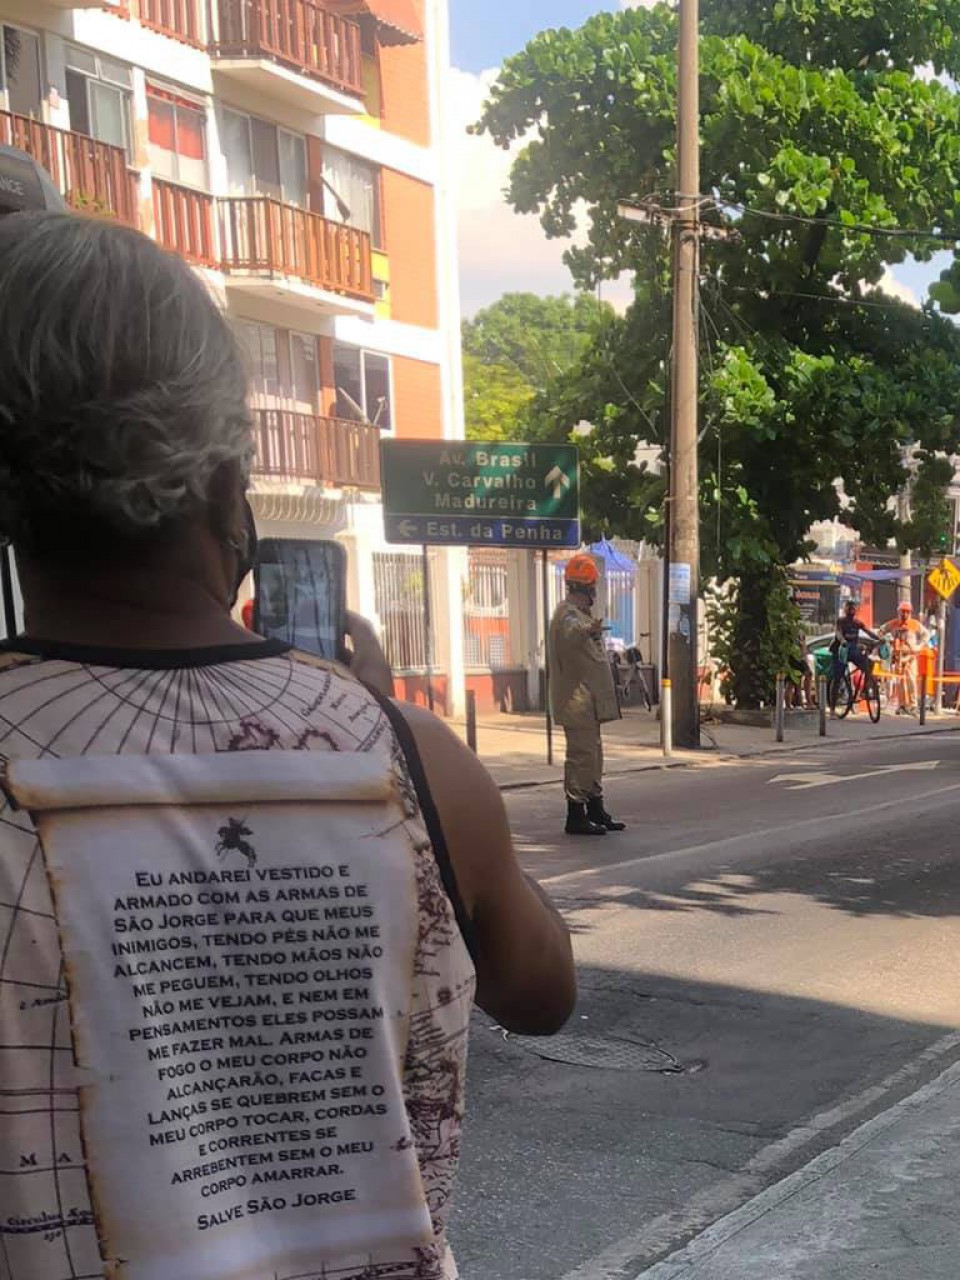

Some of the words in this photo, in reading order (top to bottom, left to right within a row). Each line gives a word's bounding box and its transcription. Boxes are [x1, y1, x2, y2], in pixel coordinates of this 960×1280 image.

[440, 452, 464, 466] Av.
[475, 452, 535, 467] Brasil
[423, 472, 439, 485] V.
[448, 472, 535, 489] Carvalho
[435, 494, 536, 511] Madureira
[426, 522, 461, 536] Est.
[471, 523, 493, 538] da
[502, 525, 562, 541] Penha
[136, 871, 162, 887] EU
[169, 869, 250, 885] ANDAREI
[256, 865, 333, 880] VESTIDO
[340, 865, 350, 877] E
[114, 894, 192, 911] ARMADO
[199, 892, 239, 905] COM
[246, 890, 269, 902] AS
[276, 886, 340, 900] ARMAS
[345, 885, 368, 897] DE
[114, 915, 153, 932] SÃO
[158, 911, 219, 930] JORGE
[224, 910, 276, 925] PARA
[282, 909, 319, 923] QUE
[324, 905, 372, 919] MEUS
[112, 936, 197, 956] INIMIGOS,
[202, 932, 267, 947] TENDO
[313, 926, 350, 941] NÃO
[356, 926, 380, 938] ME
[114, 955, 217, 978] ALCANCEM,
[221, 953, 287, 966] TENDO
[347, 945, 382, 958] NÃO
[133, 984, 155, 997] ME
[160, 975, 240, 993] PEGUEM,
[244, 971, 308, 986] TENDO
[313, 967, 373, 982] OLHOS
[143, 1001, 175, 1019] NÃO
[179, 999, 204, 1012] ME
[210, 993, 276, 1008] VEJAM,
[282, 993, 293, 1004] E
[300, 990, 337, 1002] NEM
[343, 988, 369, 999] EM
[129, 1014, 257, 1041] PENSAMENTOS
[262, 1011, 307, 1026] ELES
[312, 1006, 384, 1022] POSSAM
[148, 1046, 170, 1061] ME
[172, 1037, 223, 1056] FAZER
[229, 1035, 273, 1047] MAL.
[280, 1028, 344, 1045] ARMAS
[350, 1027, 373, 1039] DE
[158, 1061, 196, 1081] FOGO
[200, 1060, 211, 1071] O
[217, 1055, 255, 1069] MEU
[261, 1051, 324, 1066] CORPO
[329, 1046, 367, 1059] NÃO
[167, 1072, 283, 1100] ALCANÇARÃO,
[289, 1069, 346, 1085] FACAS
[351, 1067, 361, 1078] E
[148, 1102, 207, 1125] LANÇAS
[211, 1096, 232, 1111] SE
[237, 1090, 325, 1108] QUEBREM
[330, 1086, 366, 1099] SEM
[372, 1085, 384, 1096] O
[149, 1128, 185, 1146] MEU
[190, 1116, 239, 1137] CORPO
[243, 1110, 309, 1127] TOCAR,
[314, 1104, 386, 1120] CORDAS
[199, 1145, 205, 1156] E
[209, 1129, 310, 1153] CORRENTES
[316, 1127, 337, 1139] SE
[171, 1154, 273, 1185] ARREBENTEM
[278, 1148, 315, 1161] SEM
[320, 1147, 332, 1157] O
[337, 1142, 373, 1155] MEU
[201, 1175, 246, 1198] CORPO
[251, 1165, 344, 1184] AMARRAR.
[197, 1205, 244, 1230] SALVE
[247, 1197, 286, 1214] SÃO
[291, 1189, 355, 1207] JORGE
